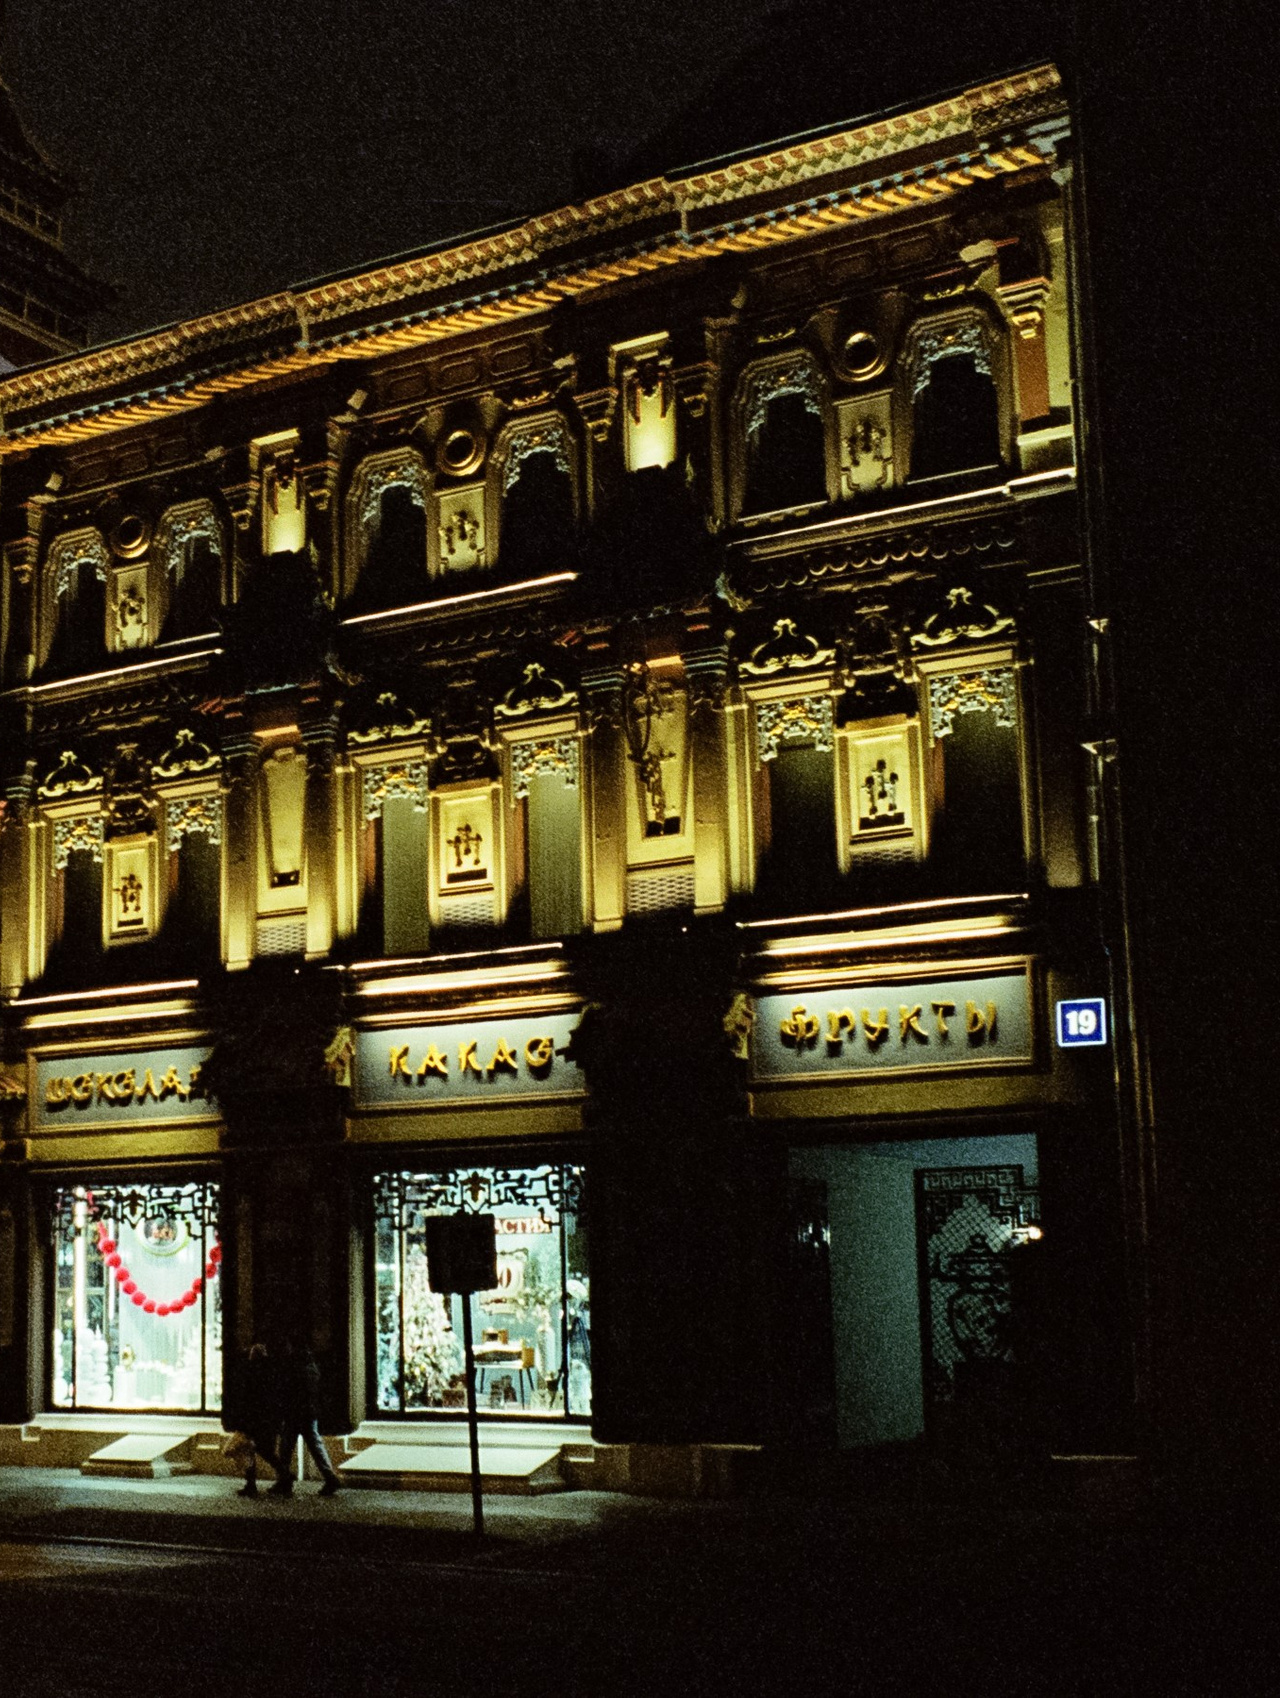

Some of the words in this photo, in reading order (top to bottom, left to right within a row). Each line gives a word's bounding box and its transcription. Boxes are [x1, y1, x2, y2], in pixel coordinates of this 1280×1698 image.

[780, 1000, 997, 1042] ФРУКТЫ
[1065, 1009, 1097, 1036] 19
[389, 1037, 553, 1077] КАКАО
